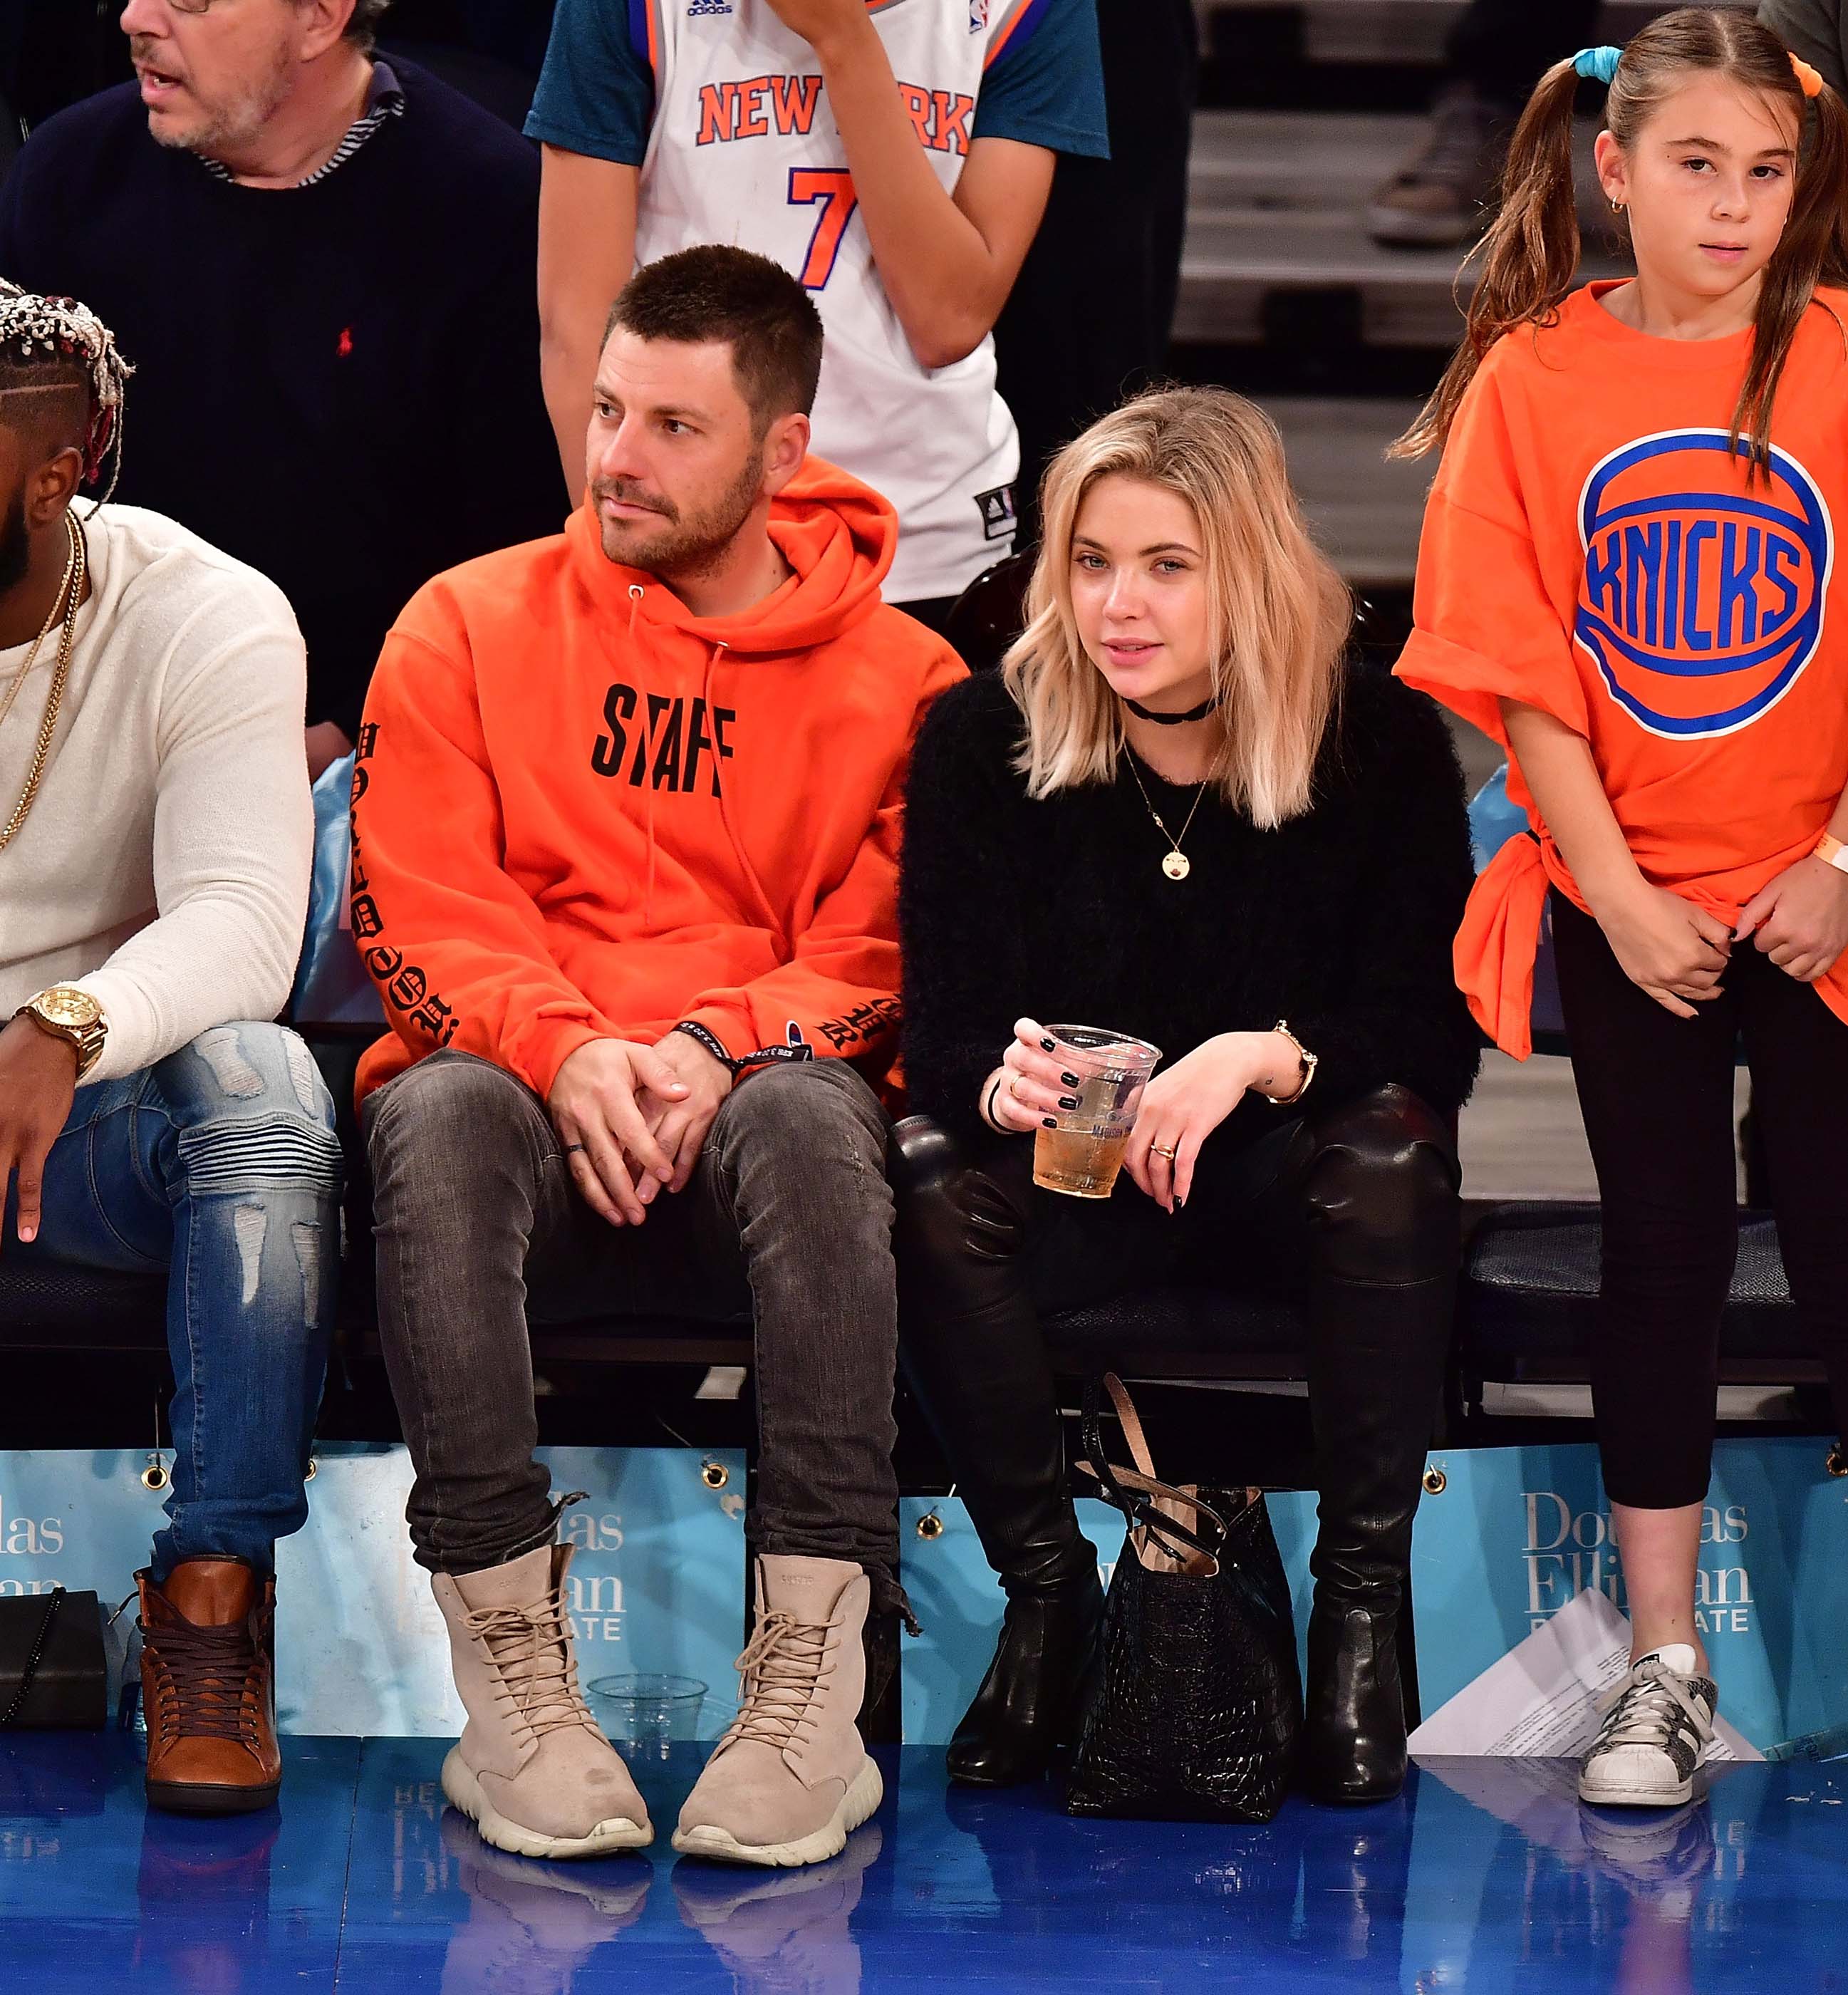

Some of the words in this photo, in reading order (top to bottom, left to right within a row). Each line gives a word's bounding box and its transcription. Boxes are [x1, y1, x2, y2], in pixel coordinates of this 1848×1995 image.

[695, 75, 823, 147] NEW
[787, 167, 859, 291] 7
[1585, 519, 1800, 651] KNICKS
[591, 683, 737, 799] STAFF
